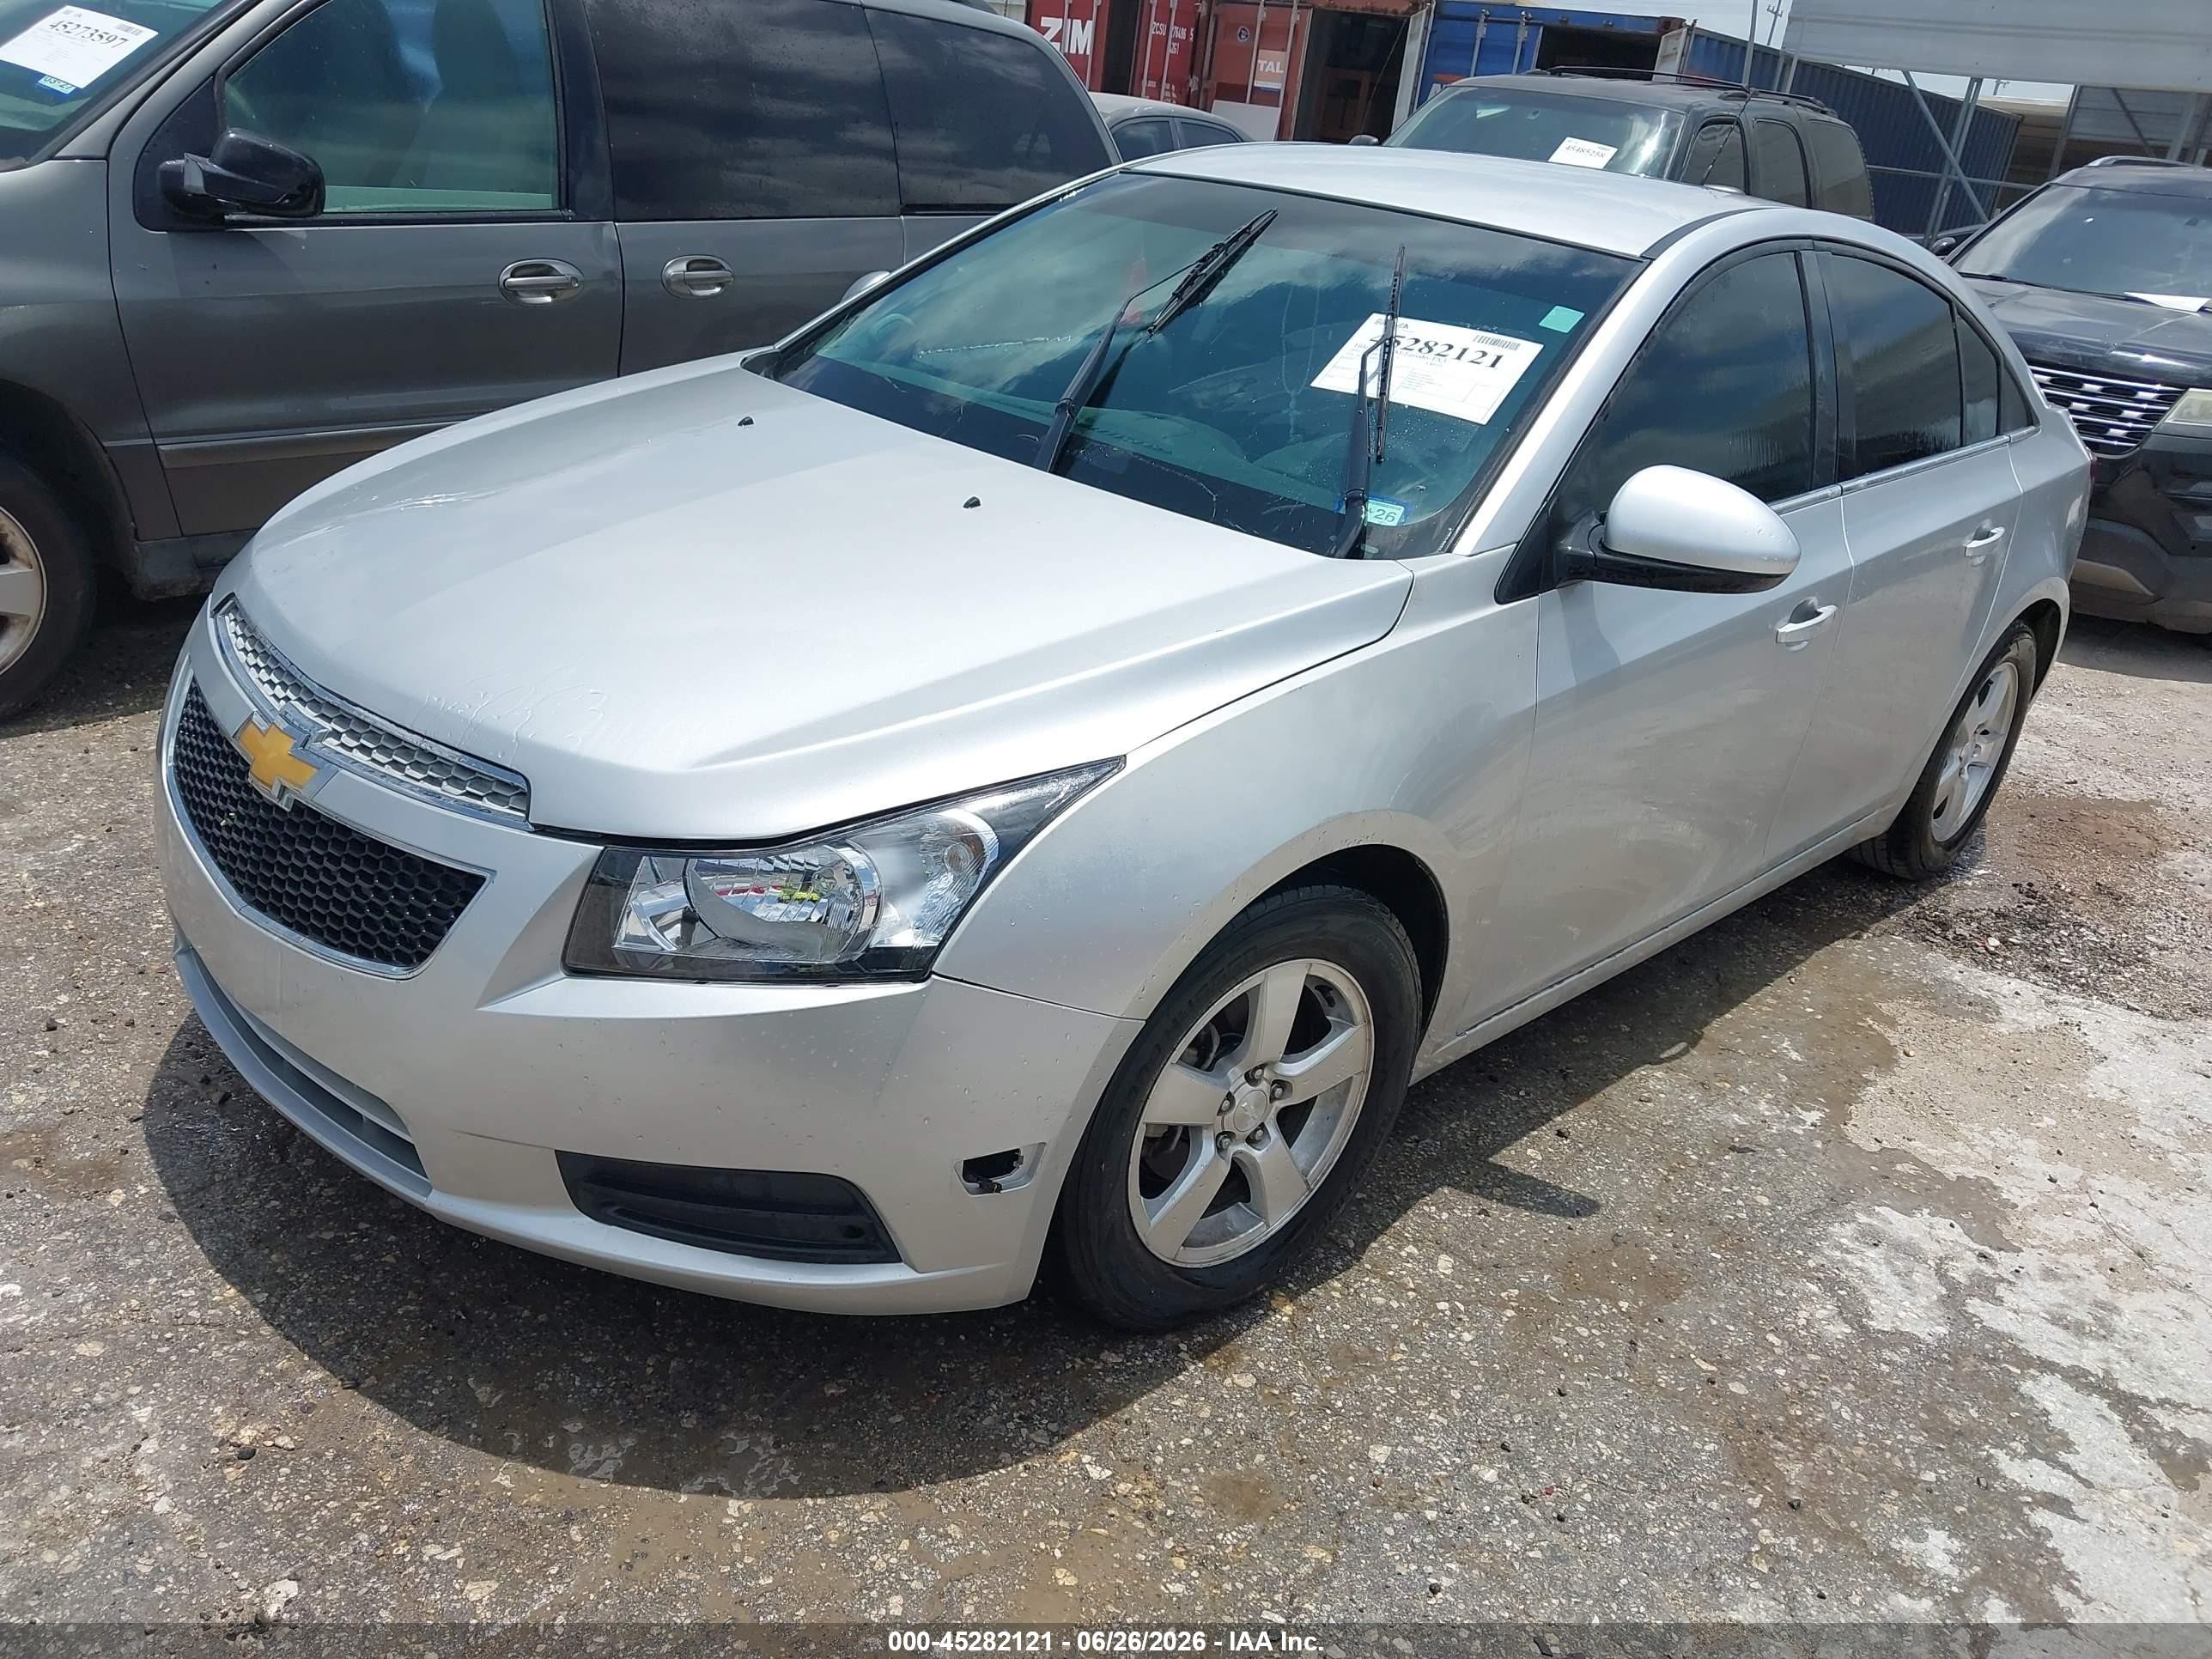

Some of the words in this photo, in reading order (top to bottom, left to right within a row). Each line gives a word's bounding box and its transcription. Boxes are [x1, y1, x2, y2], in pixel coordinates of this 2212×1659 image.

[49, 19, 130, 48] 45273597
[1041, 16, 1094, 55] ZIM
[1152, 21, 1167, 36] ZCSU
[1257, 59, 1285, 74] TAL
[1374, 508, 1397, 523] 26
